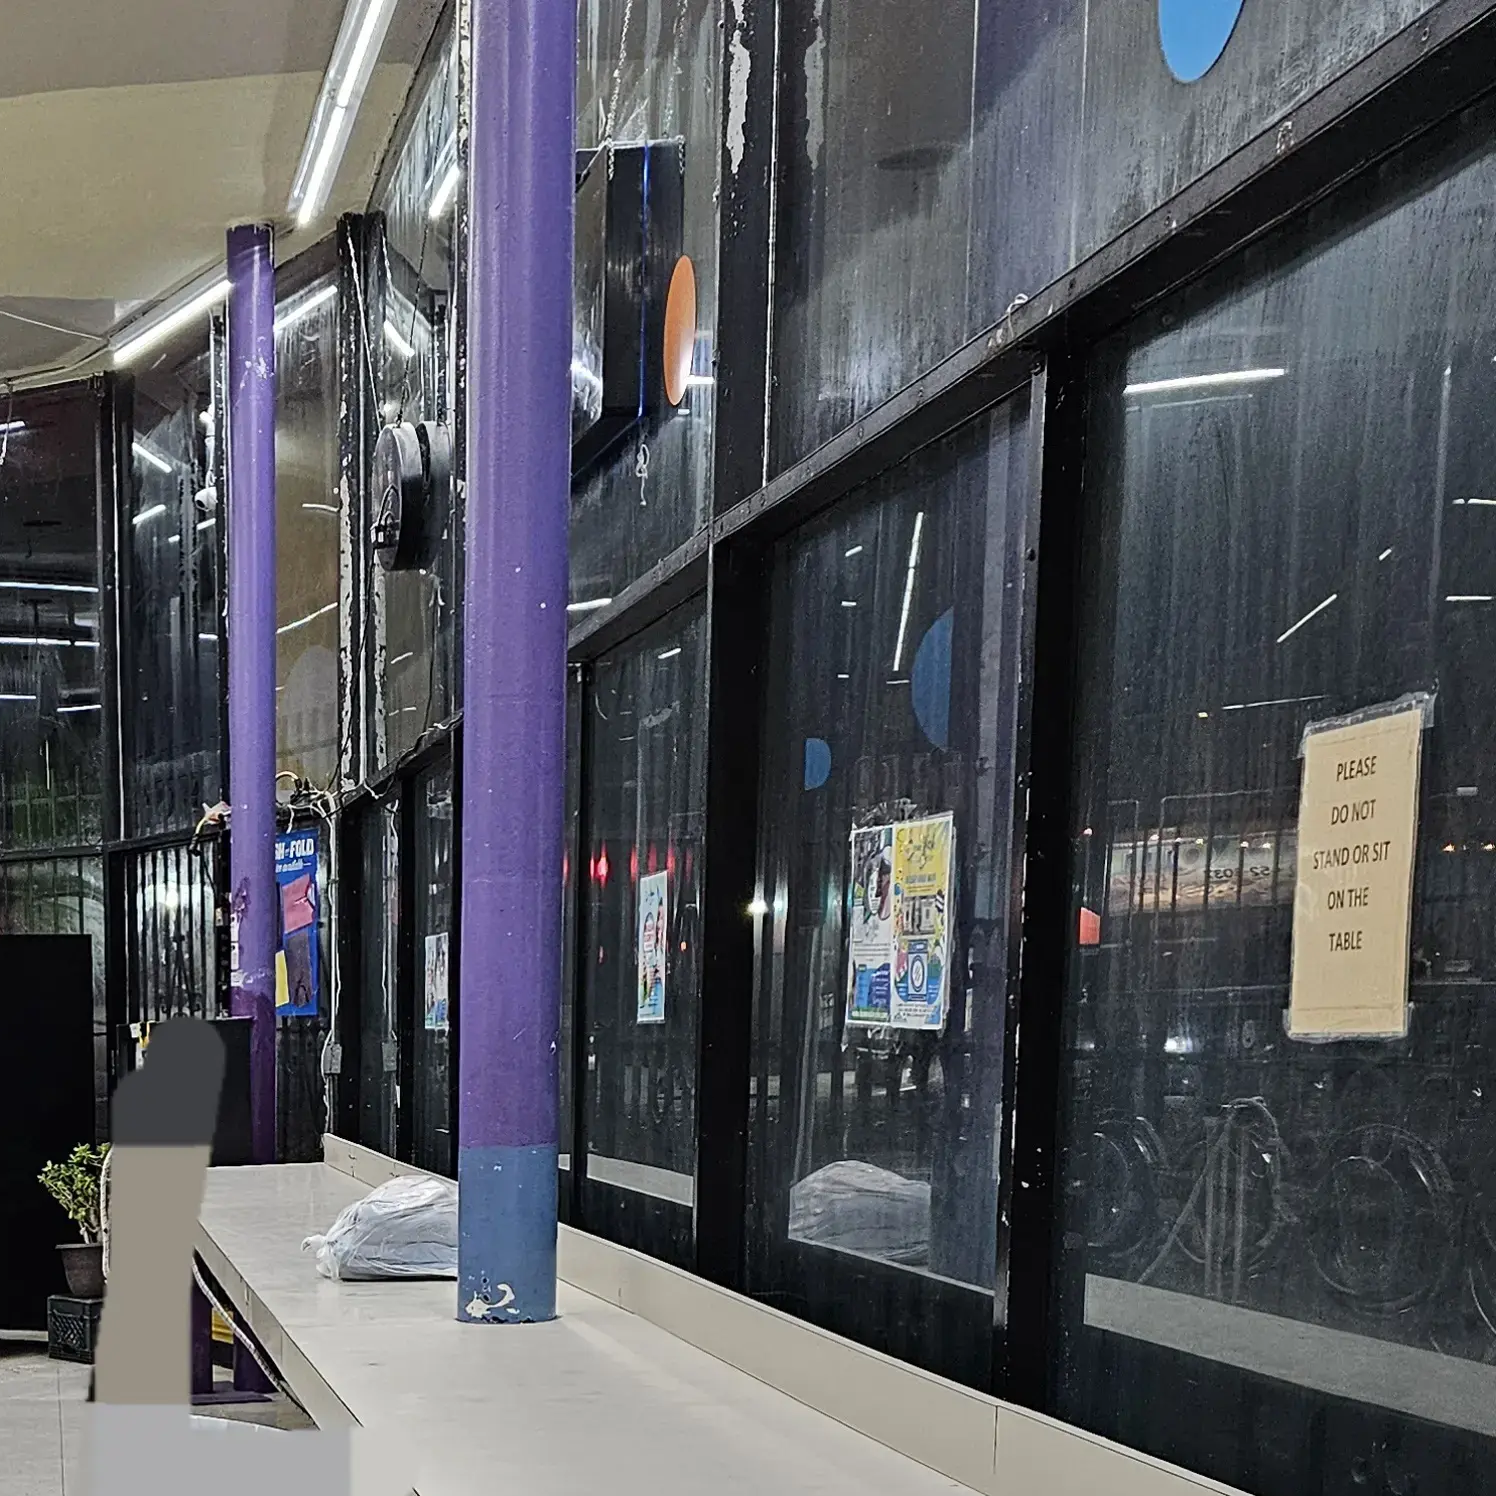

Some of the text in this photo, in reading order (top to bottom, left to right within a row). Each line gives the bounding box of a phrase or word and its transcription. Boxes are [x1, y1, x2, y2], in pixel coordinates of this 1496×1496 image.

[1336, 755, 1377, 782] PLEASE
[1331, 799, 1376, 826] DO NOT
[1312, 840, 1390, 870] STAND OR SIT
[1327, 886, 1369, 910] ON THE
[1328, 930, 1363, 952] TABLE
